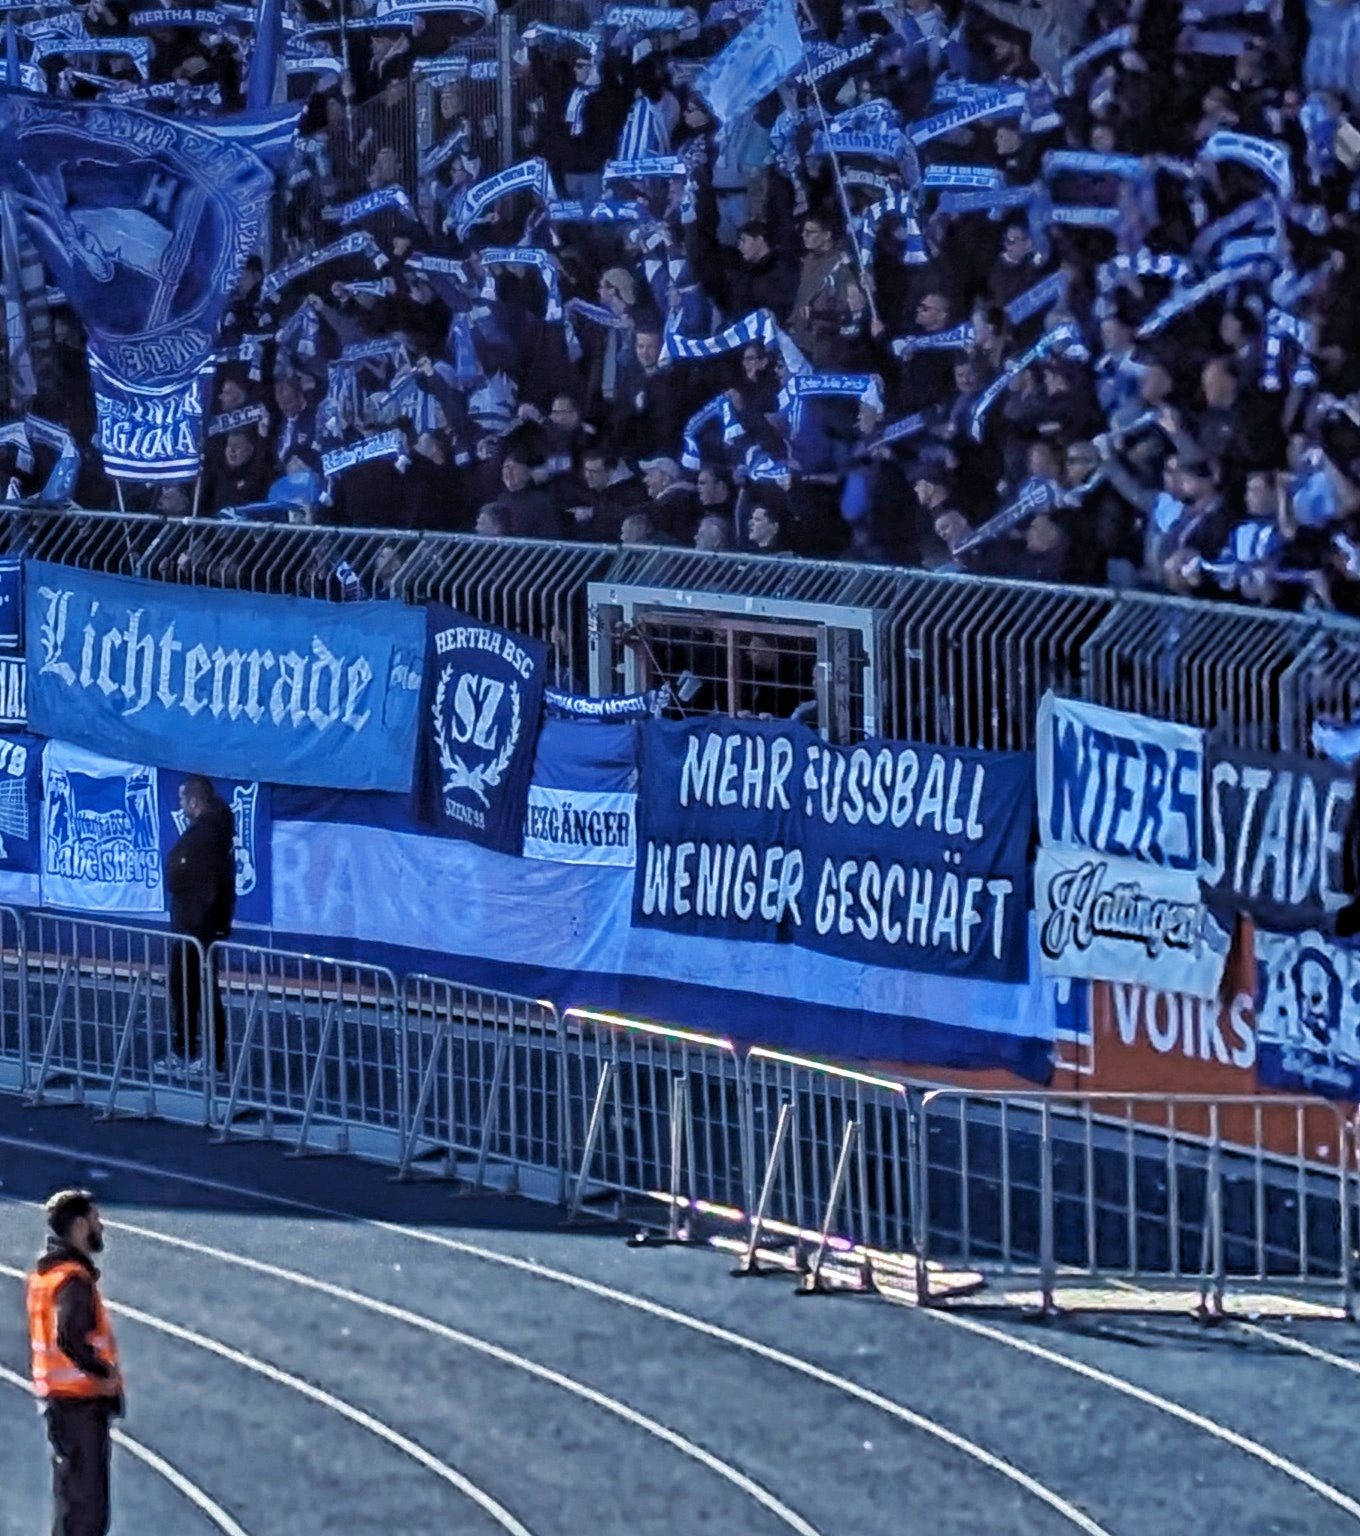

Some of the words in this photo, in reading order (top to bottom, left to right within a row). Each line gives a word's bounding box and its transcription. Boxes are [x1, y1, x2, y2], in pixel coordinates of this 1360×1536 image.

[100, 421, 197, 458] EGIONA
[38, 585, 373, 731] Lichtenrade
[435, 627, 500, 655] HERTHA
[502, 639, 534, 679] BSC
[452, 673, 505, 750] SZ
[680, 732, 794, 810] MEHR
[804, 744, 985, 840] FUSSBALL
[642, 840, 803, 927] WENIGER
[815, 850, 1014, 960] GESCHÄFT
